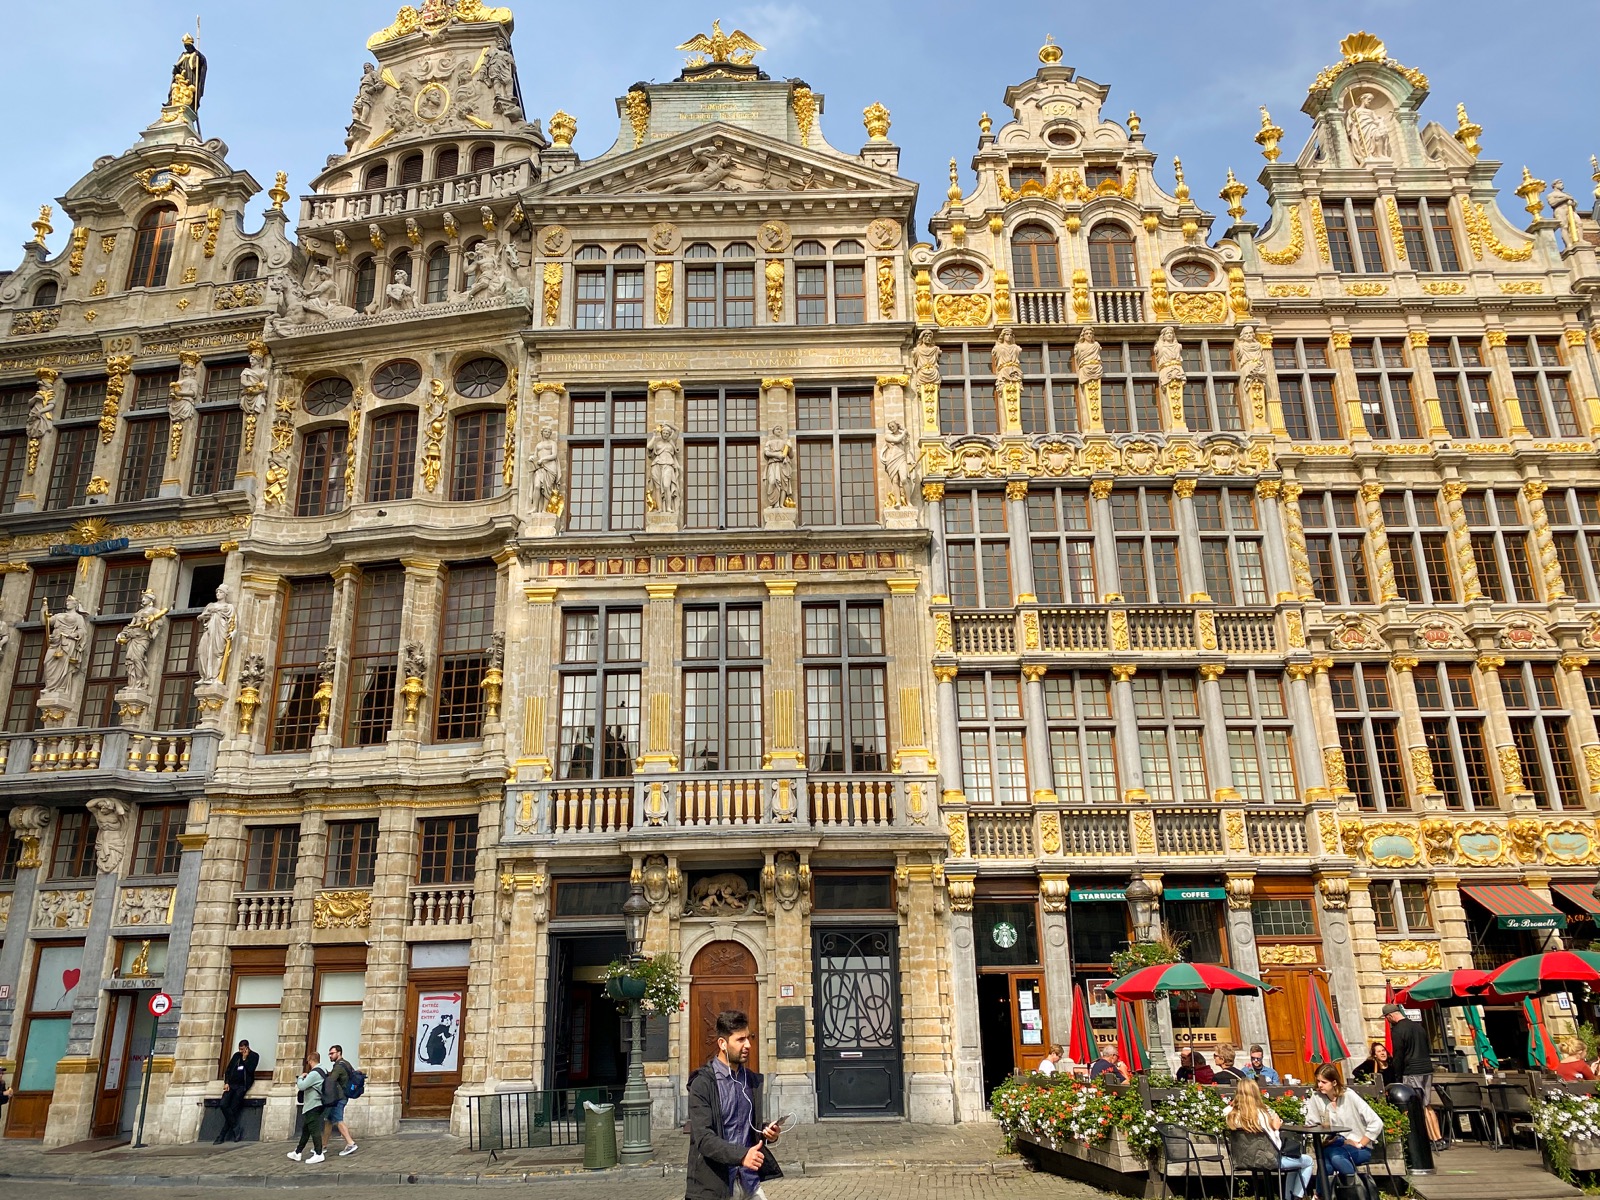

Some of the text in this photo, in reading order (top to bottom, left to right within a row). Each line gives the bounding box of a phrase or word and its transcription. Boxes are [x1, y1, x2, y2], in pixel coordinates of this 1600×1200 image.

[1044, 104, 1075, 116] 1697
[104, 337, 132, 353] 1699
[1181, 891, 1210, 899] COFFEE
[1506, 919, 1519, 928] La
[1520, 918, 1557, 928] Brouette
[110, 979, 156, 988] IN DEN VOS
[1174, 1033, 1217, 1042] COFFEE
